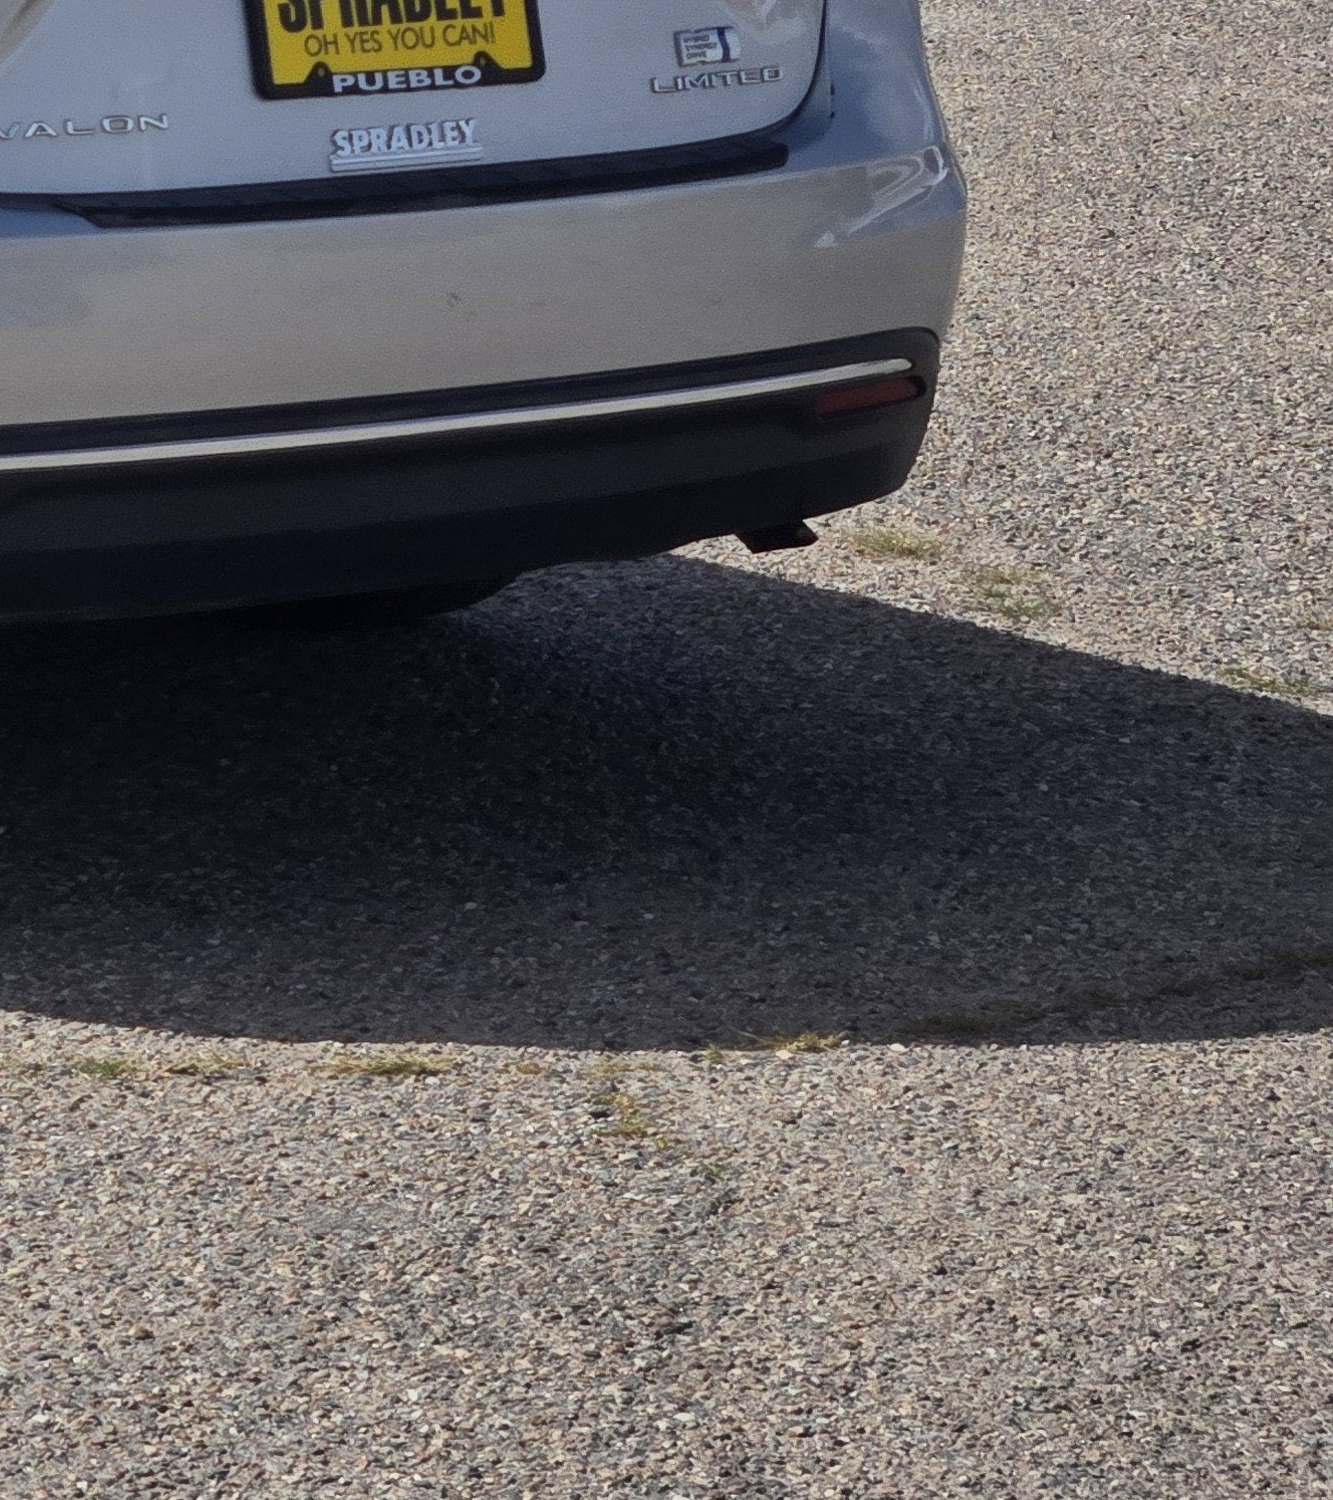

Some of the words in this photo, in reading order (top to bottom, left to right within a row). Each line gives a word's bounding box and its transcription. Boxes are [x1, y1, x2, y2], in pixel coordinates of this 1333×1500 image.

[304, 34, 339, 58] OH
[345, 30, 383, 55] YES
[386, 25, 435, 52] YOU
[442, 21, 495, 47] CAN!
[333, 65, 482, 93] PUEBLO
[650, 65, 783, 93] LIMITED
[332, 117, 479, 157] SPRADLEY
